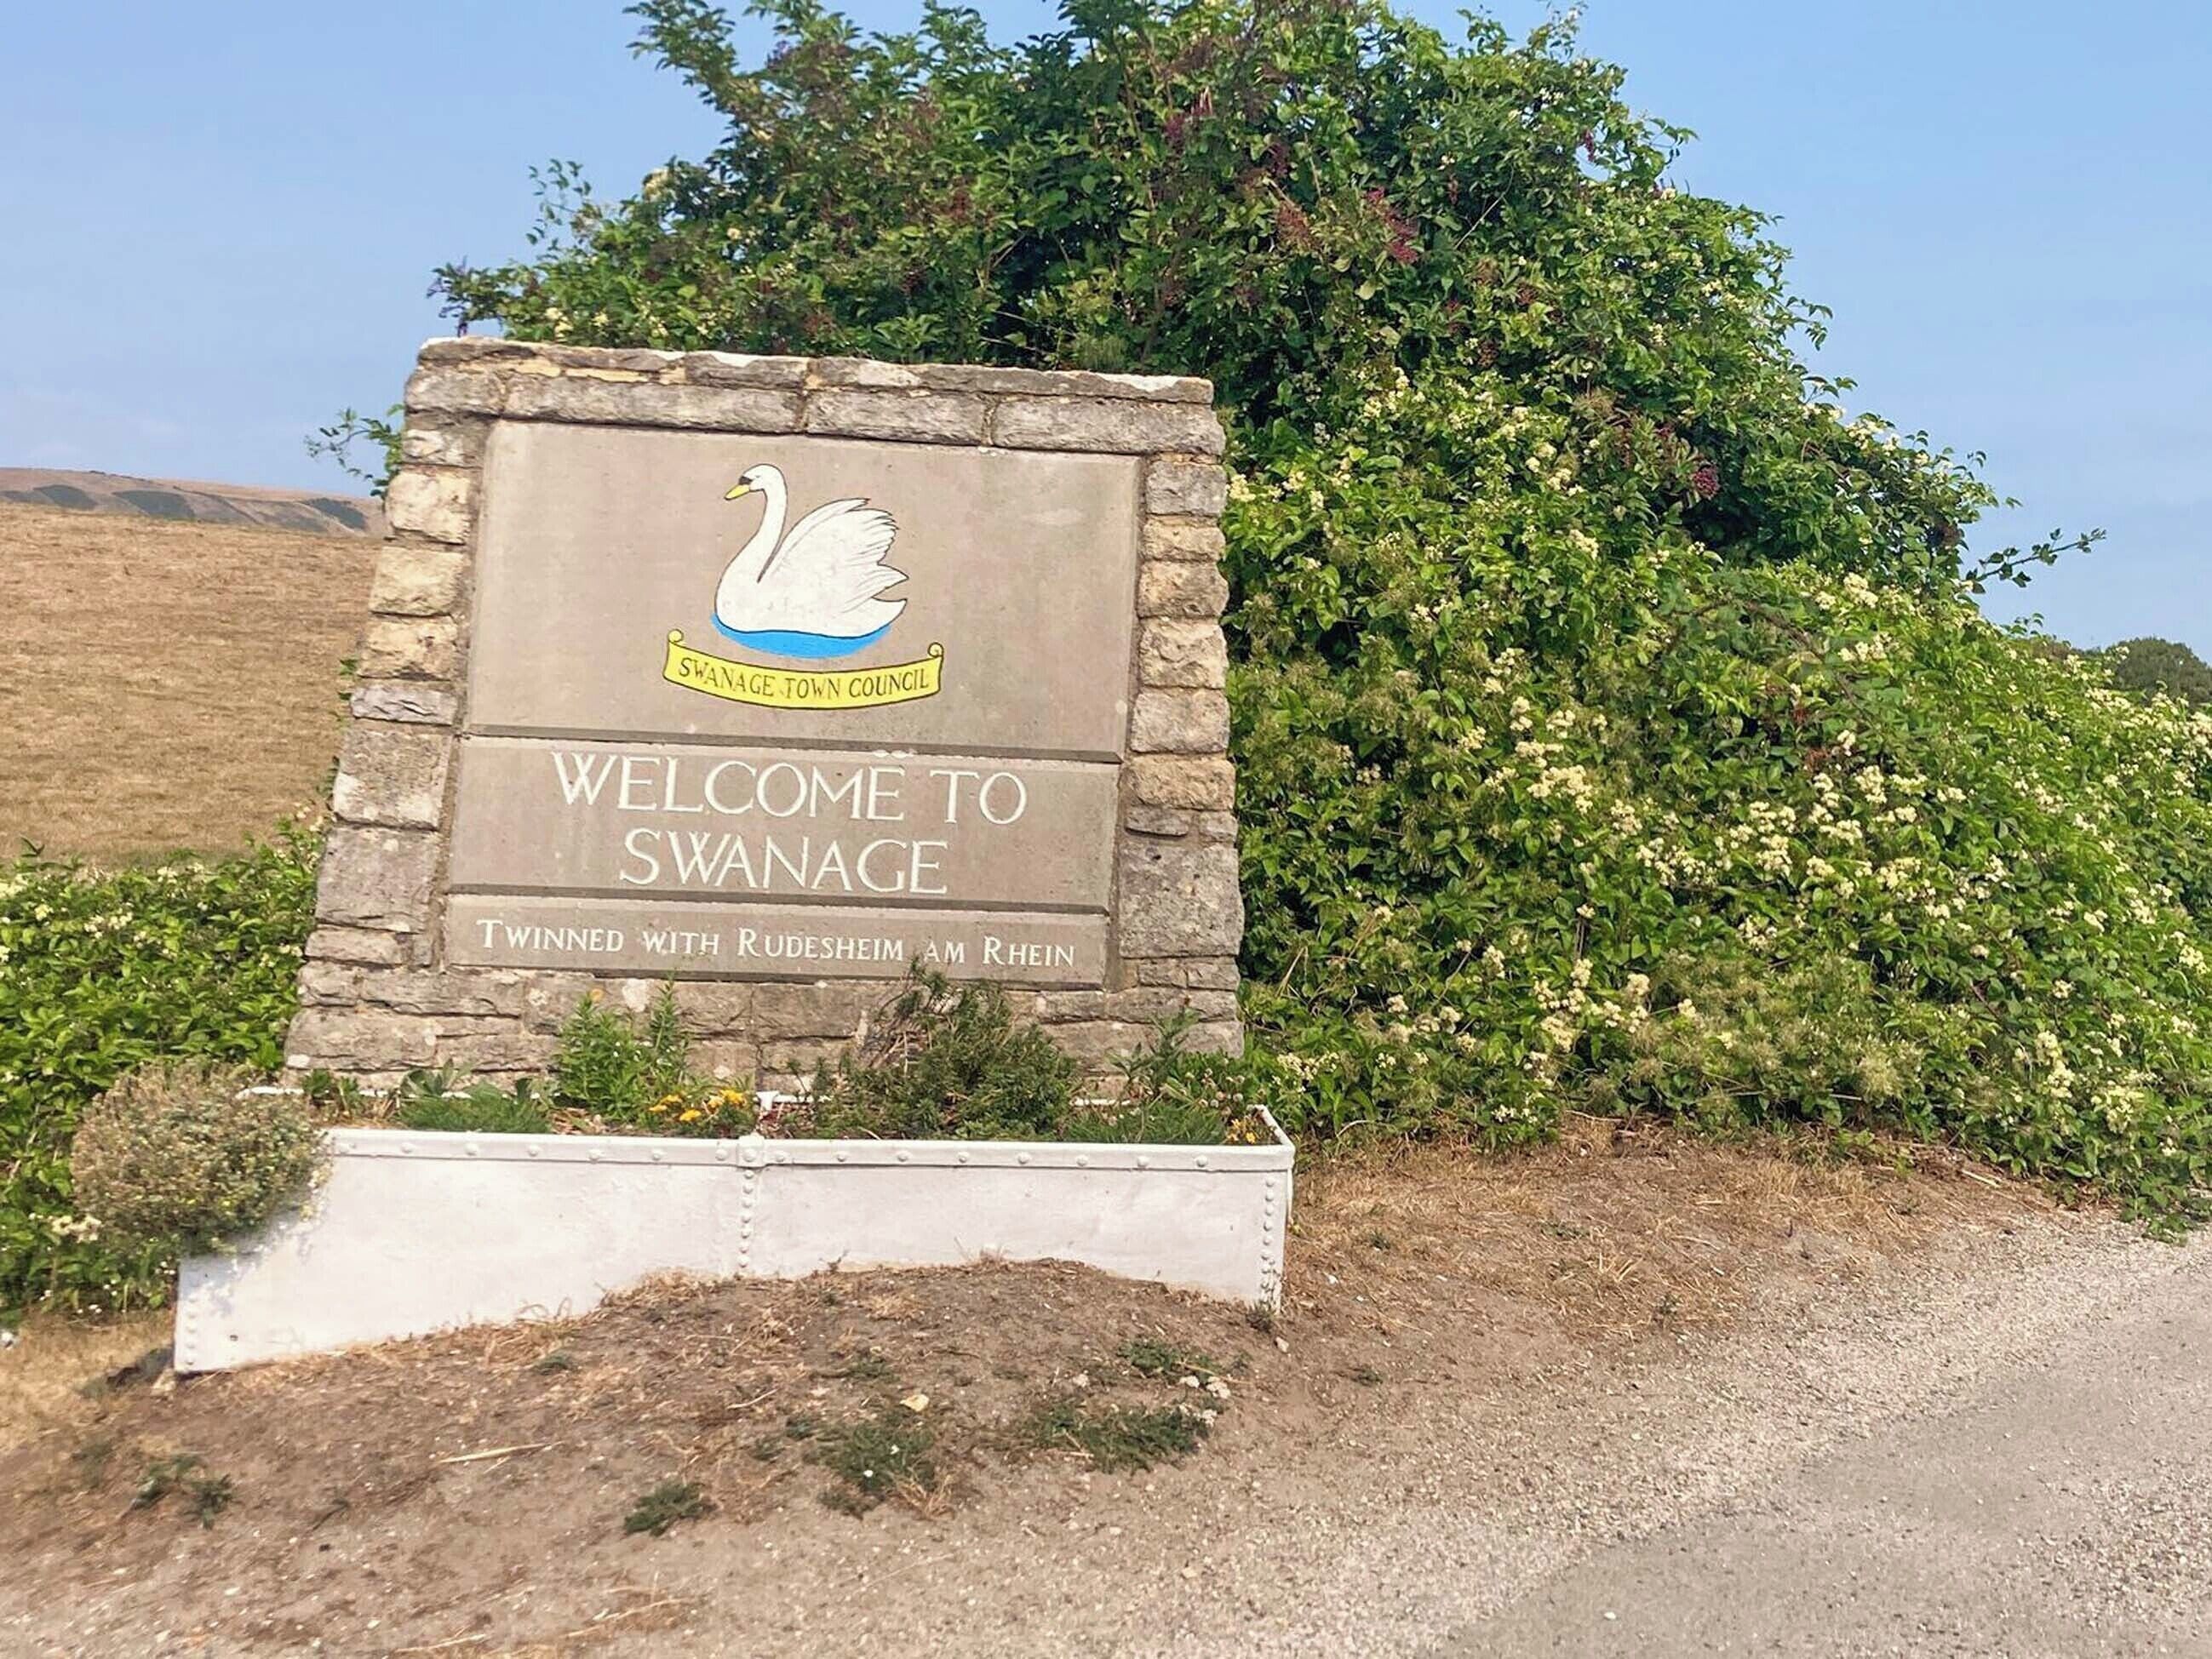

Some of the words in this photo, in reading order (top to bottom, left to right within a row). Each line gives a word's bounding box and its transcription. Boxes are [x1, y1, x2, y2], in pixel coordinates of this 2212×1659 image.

[679, 656, 776, 697] SWANAGE
[784, 677, 840, 701] TOWN
[848, 668, 930, 698] COUNCIL
[551, 752, 906, 821] WELCOME
[930, 768, 1028, 825] TO
[619, 827, 948, 895] SWANAGE
[476, 918, 624, 952] TWINNED
[642, 930, 719, 956] WITH
[737, 927, 903, 962] RUDESHEIM
[924, 939, 966, 964] AM
[983, 936, 1075, 967] RHEIN
